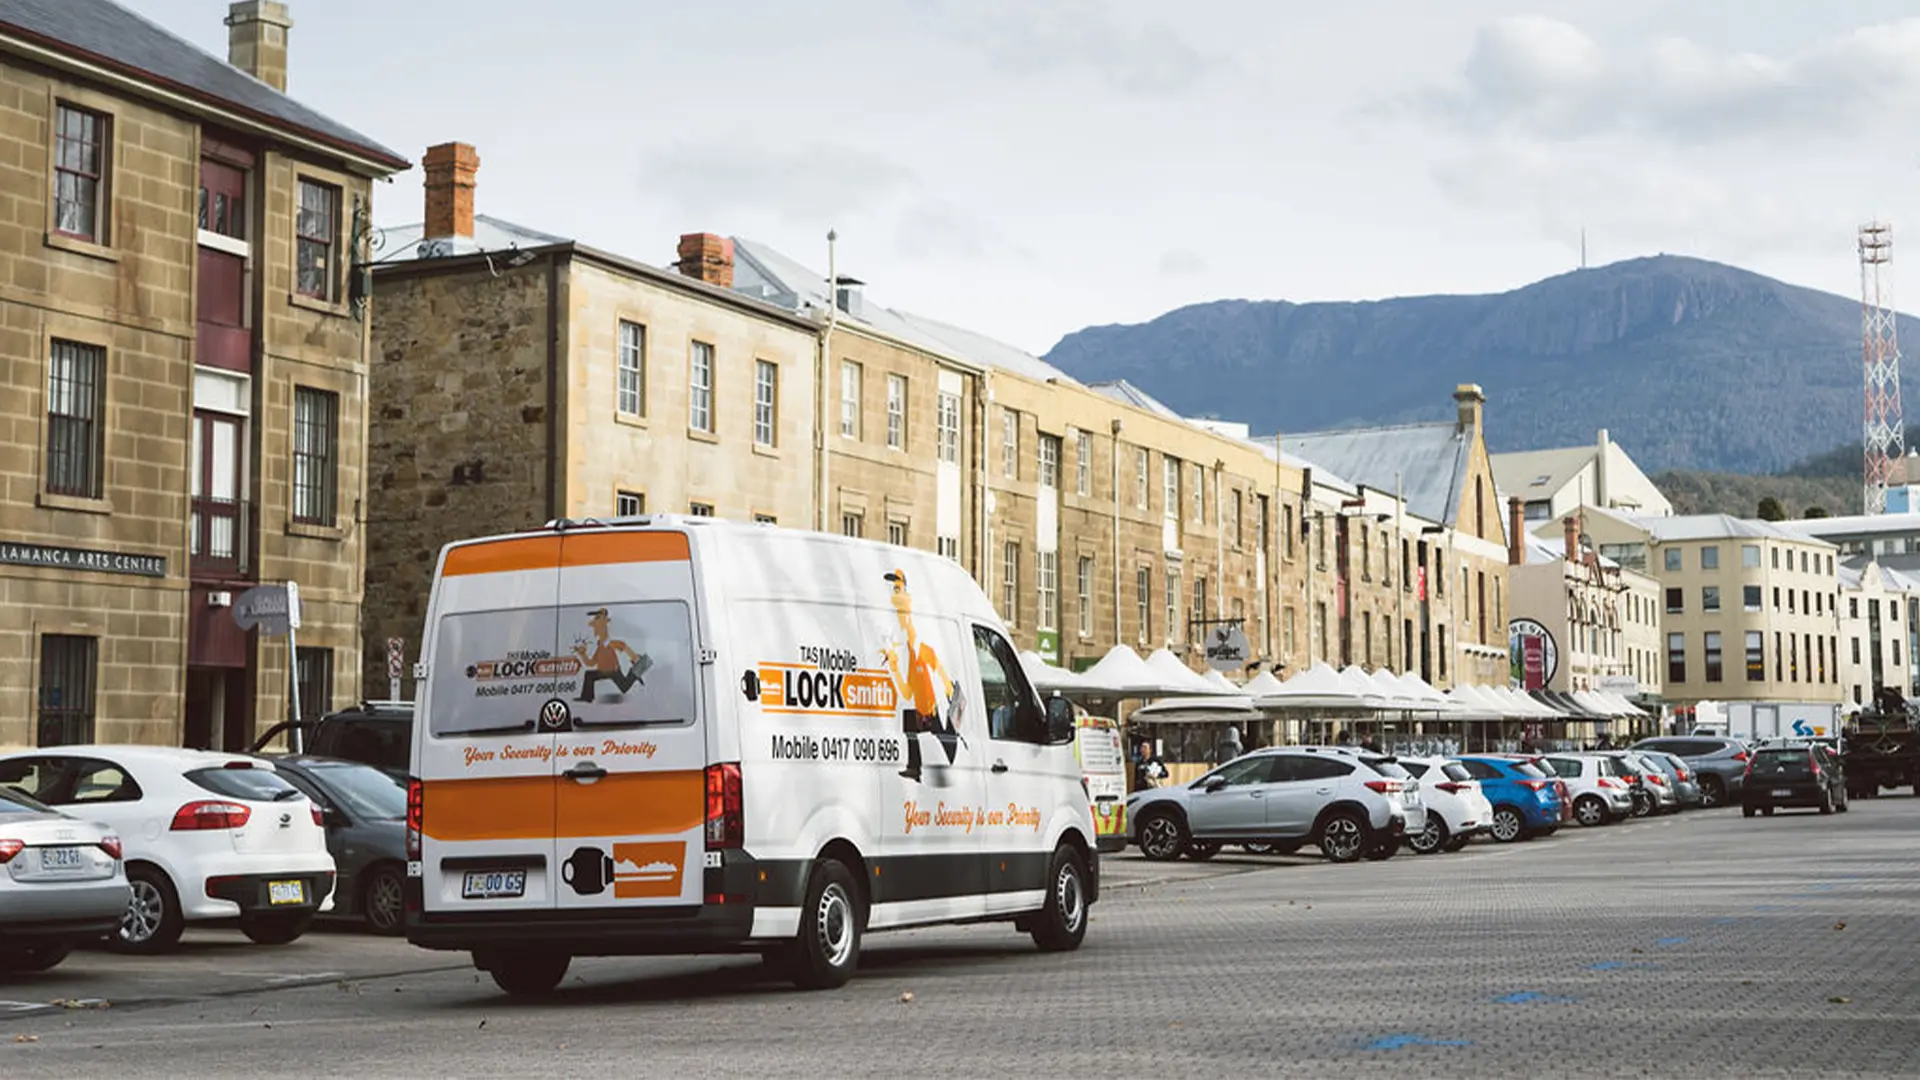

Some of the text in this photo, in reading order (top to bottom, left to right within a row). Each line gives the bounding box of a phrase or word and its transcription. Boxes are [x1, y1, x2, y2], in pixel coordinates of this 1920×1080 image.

[77, 552, 110, 568] ARTS
[115, 555, 161, 573] CENTRE
[800, 645, 858, 673] TAS Mobile
[475, 685, 509, 698] Mobile
[510, 682, 534, 696] 0417
[535, 681, 556, 694] 090
[785, 670, 893, 709] LOCK smith
[463, 739, 657, 768] Your Security is our Priority
[772, 734, 900, 762] Mobile 0417 090 696
[904, 800, 1042, 834] Your Security is our Priority
